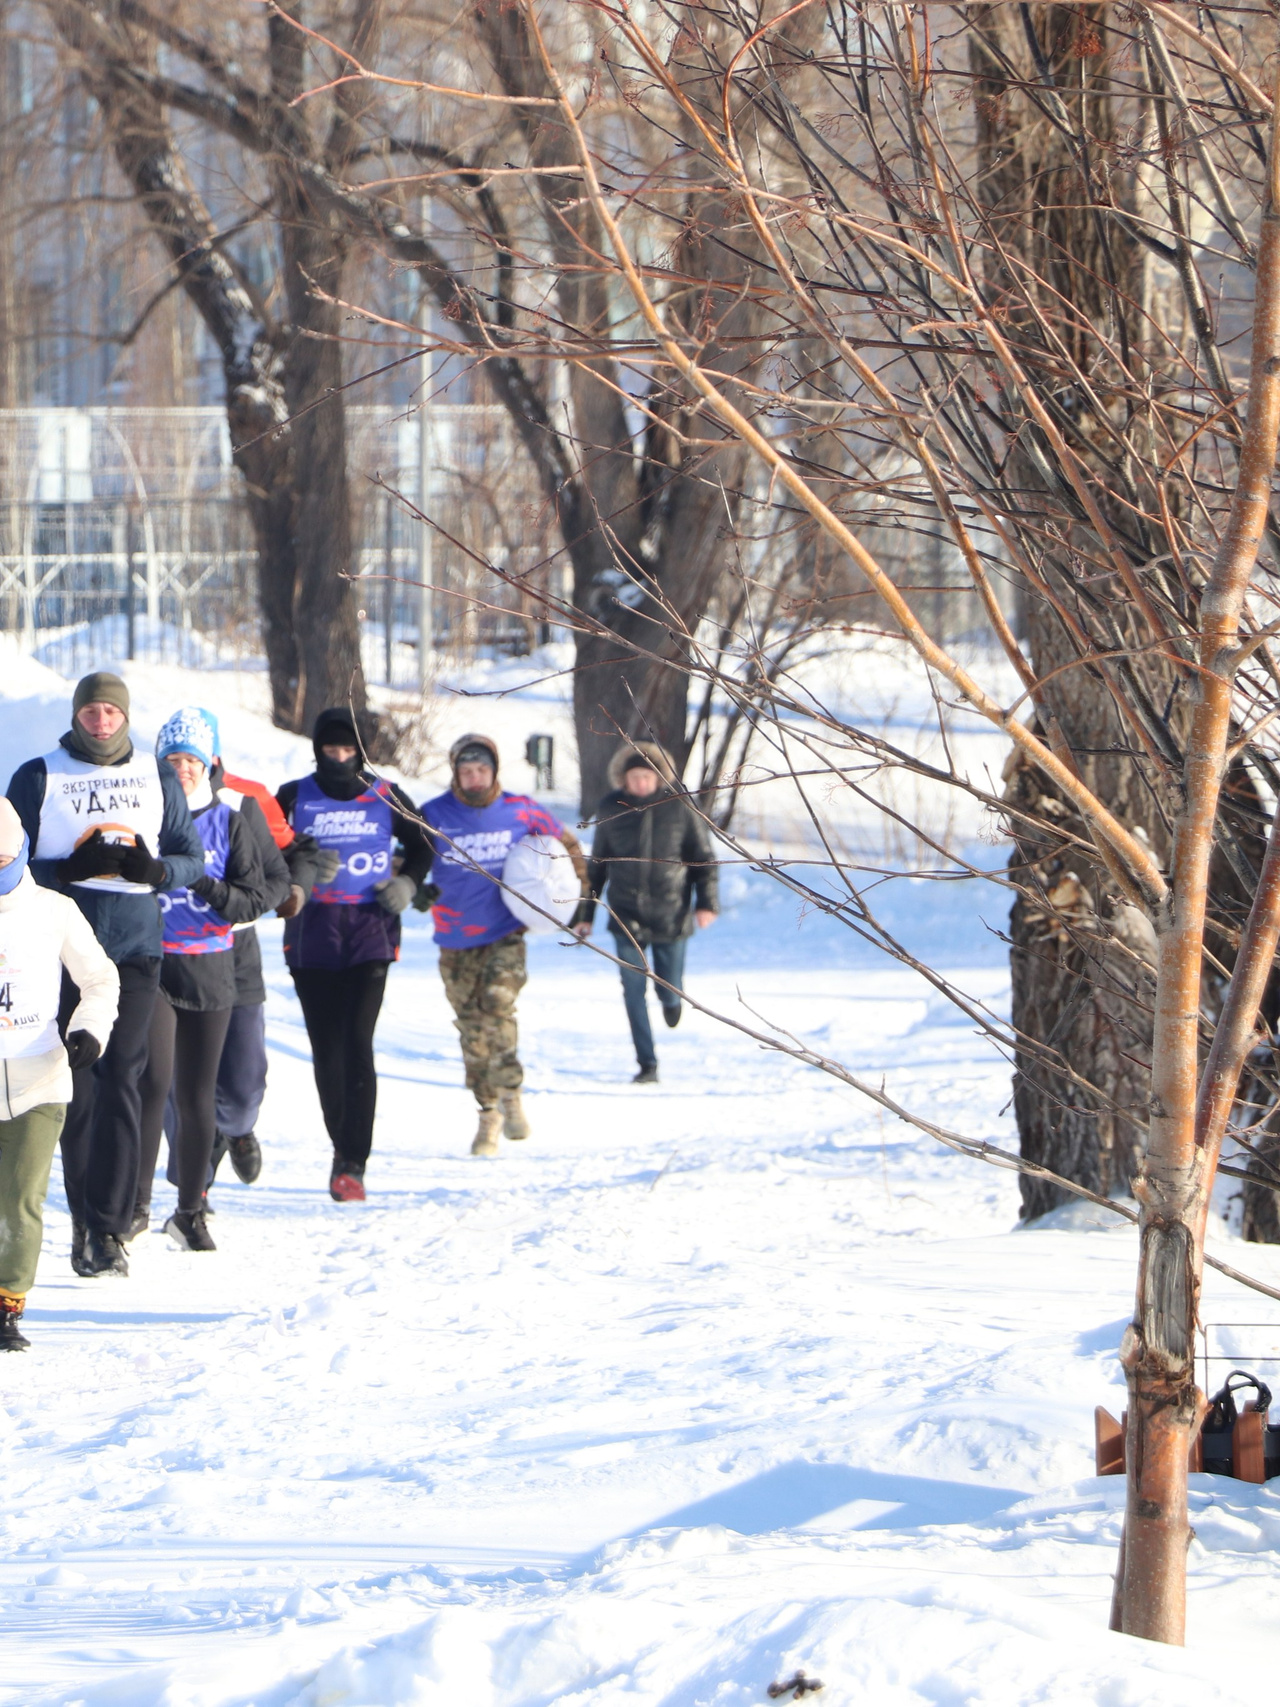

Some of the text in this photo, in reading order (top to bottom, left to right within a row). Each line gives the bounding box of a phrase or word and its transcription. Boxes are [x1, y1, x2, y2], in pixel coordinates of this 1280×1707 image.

[62, 777, 147, 795] ЭКСТРЕМАЛЫ
[71, 791, 141, 815] УДАЧИ
[313, 810, 367, 827] ВРЕМЯ
[451, 829, 512, 851] ВРЕМЯ
